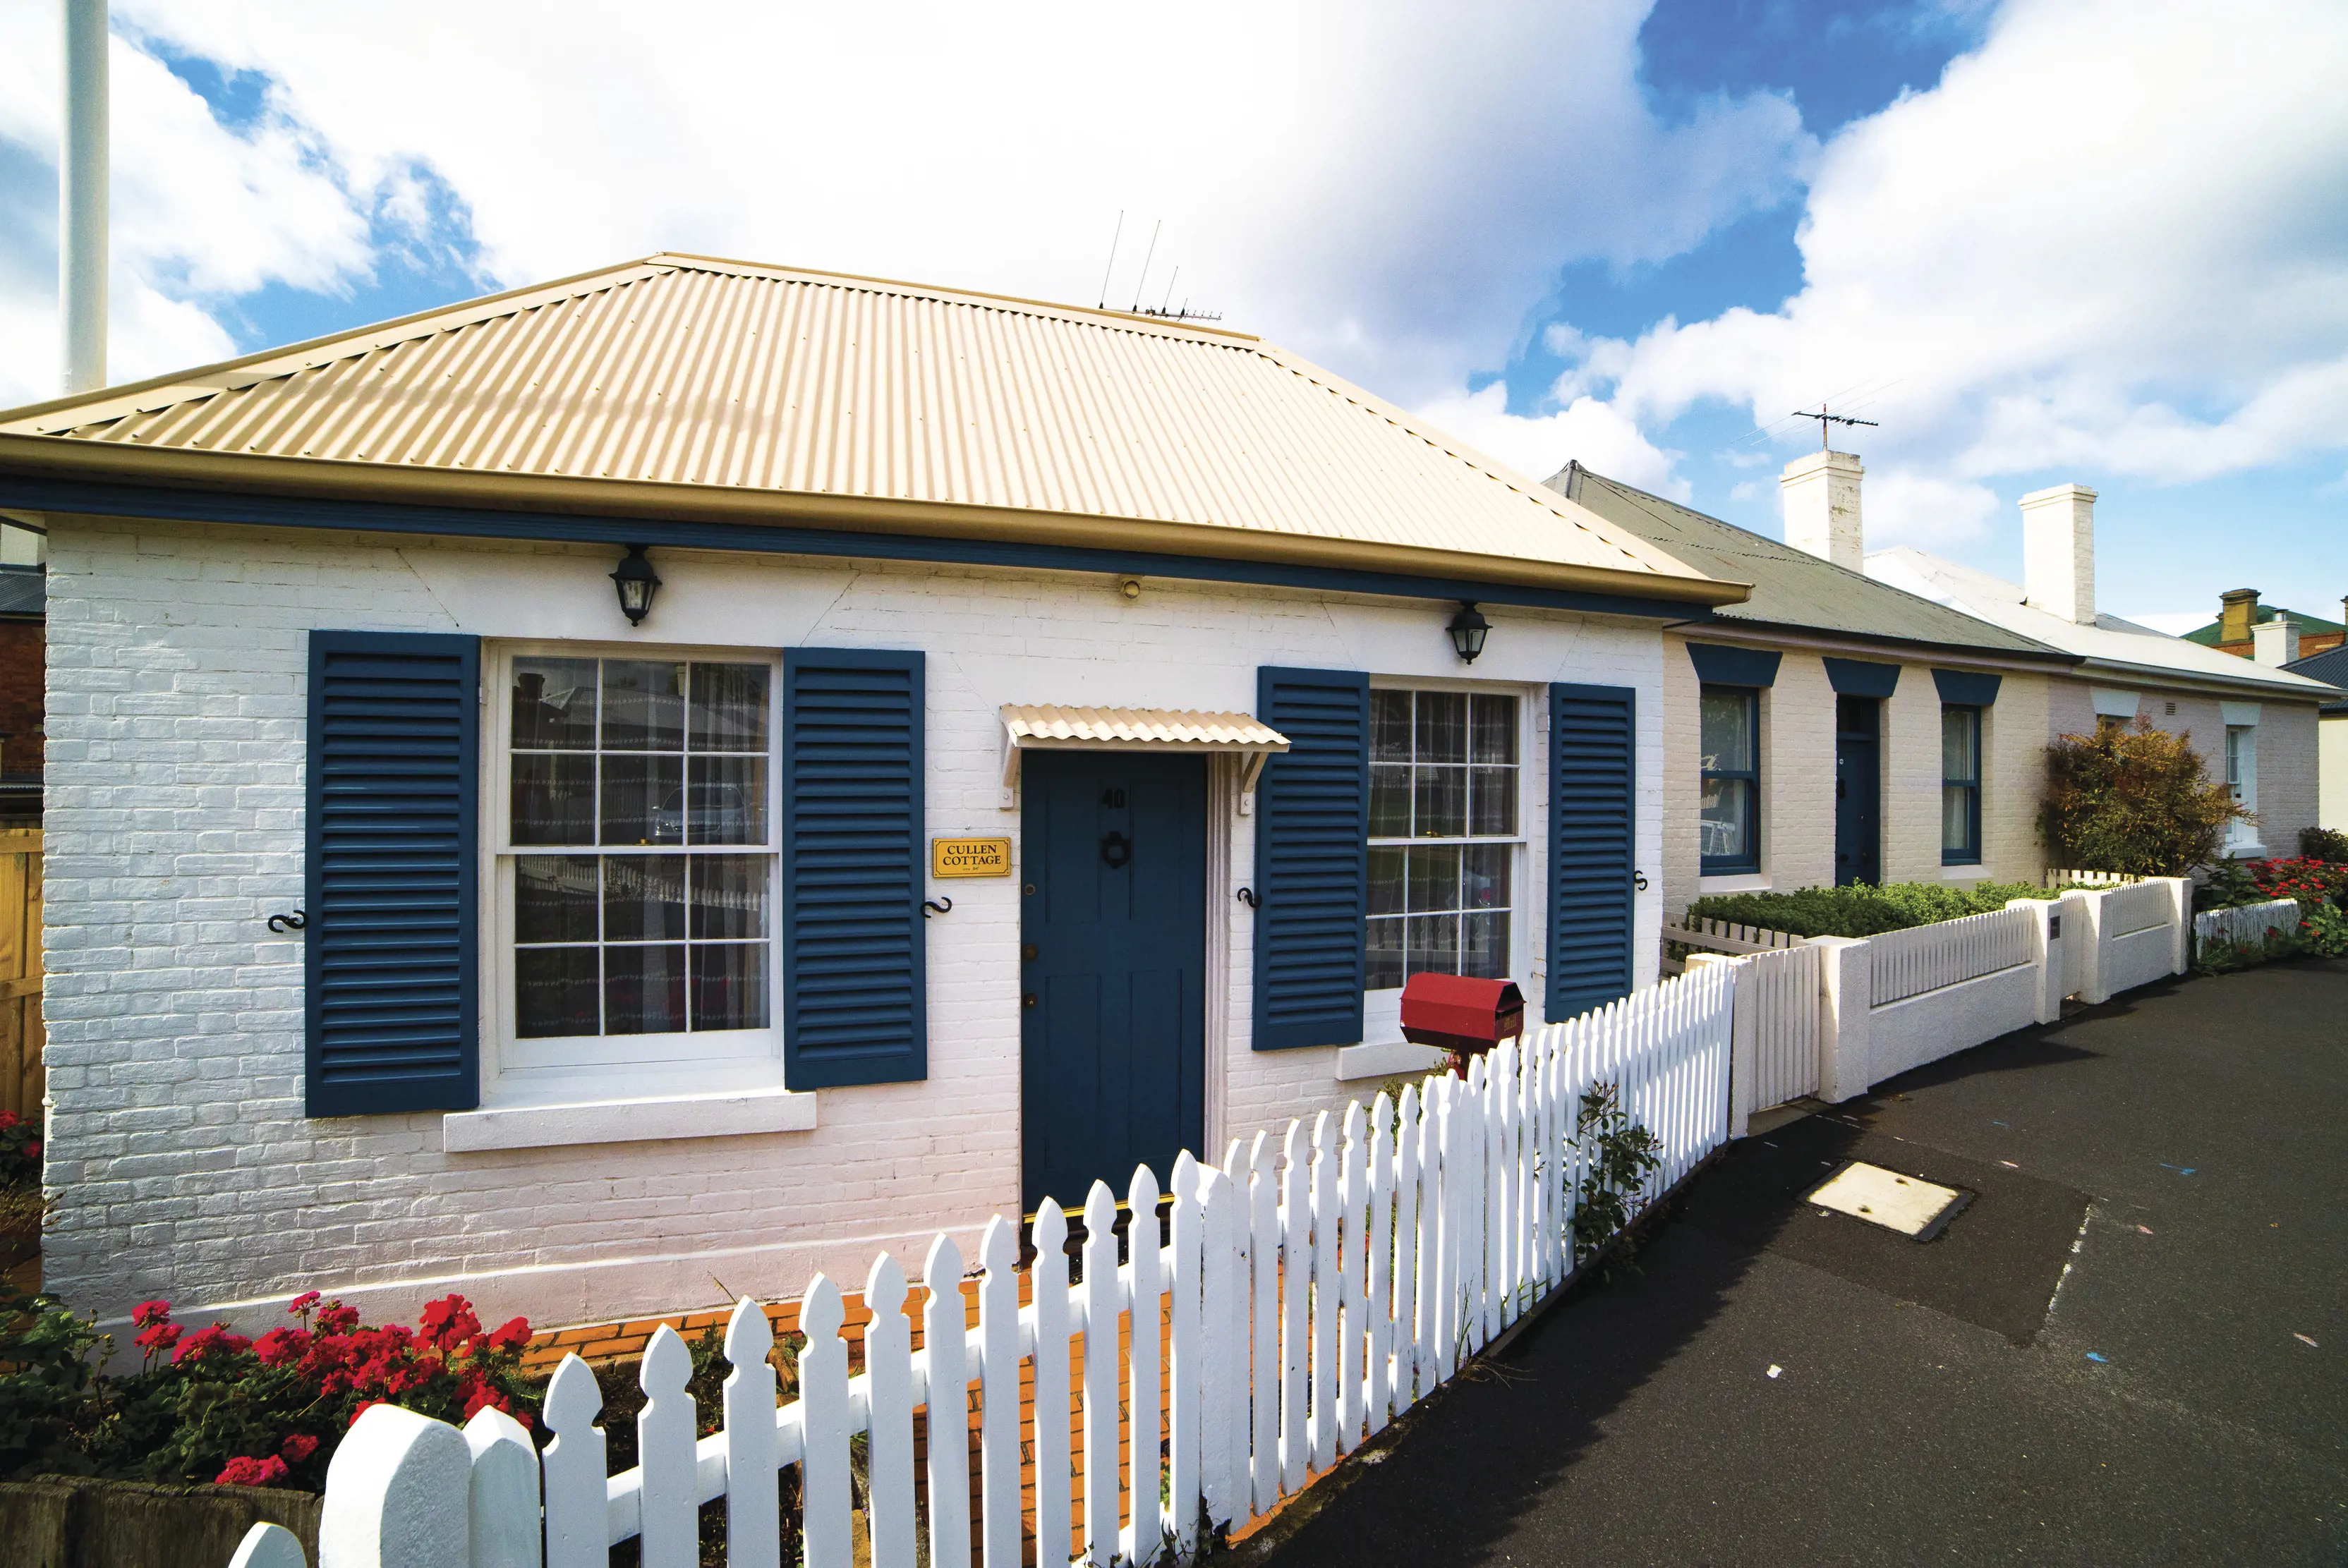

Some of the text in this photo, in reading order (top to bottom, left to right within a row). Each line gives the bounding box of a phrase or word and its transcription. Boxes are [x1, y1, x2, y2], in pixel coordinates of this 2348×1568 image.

[1102, 788, 1125, 809] 40
[947, 844, 997, 854] CULLEN
[943, 856, 1001, 865] COTTAGE
